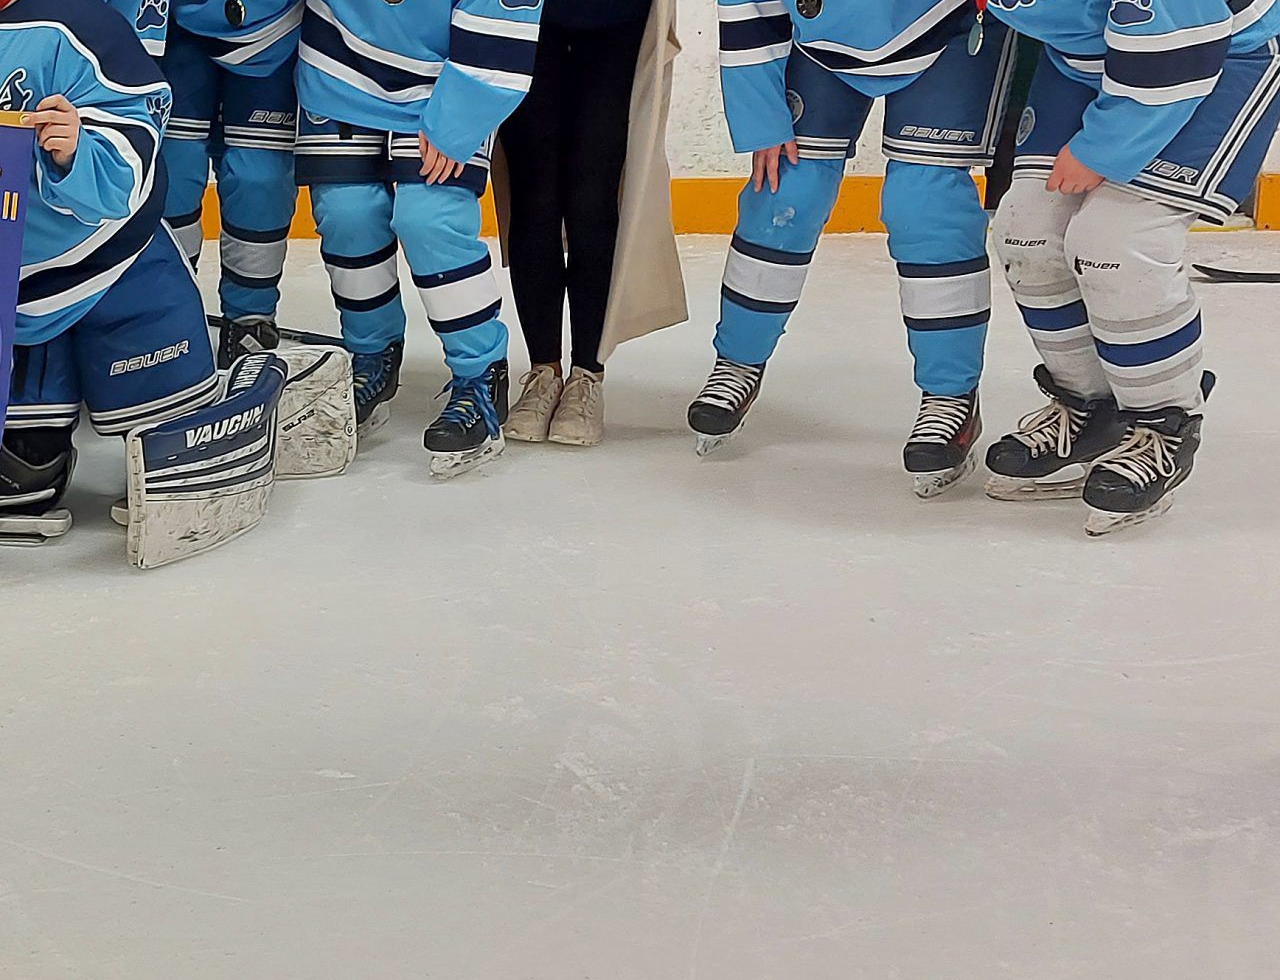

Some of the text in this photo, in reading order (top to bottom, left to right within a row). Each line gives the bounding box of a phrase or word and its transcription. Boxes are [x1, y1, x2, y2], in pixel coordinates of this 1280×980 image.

[899, 125, 976, 142] BAUER
[2, 191, 20, 221] II
[1004, 237, 1047, 247] BAUER
[109, 340, 190, 377] BAUER
[185, 404, 265, 449] VAUGHN
